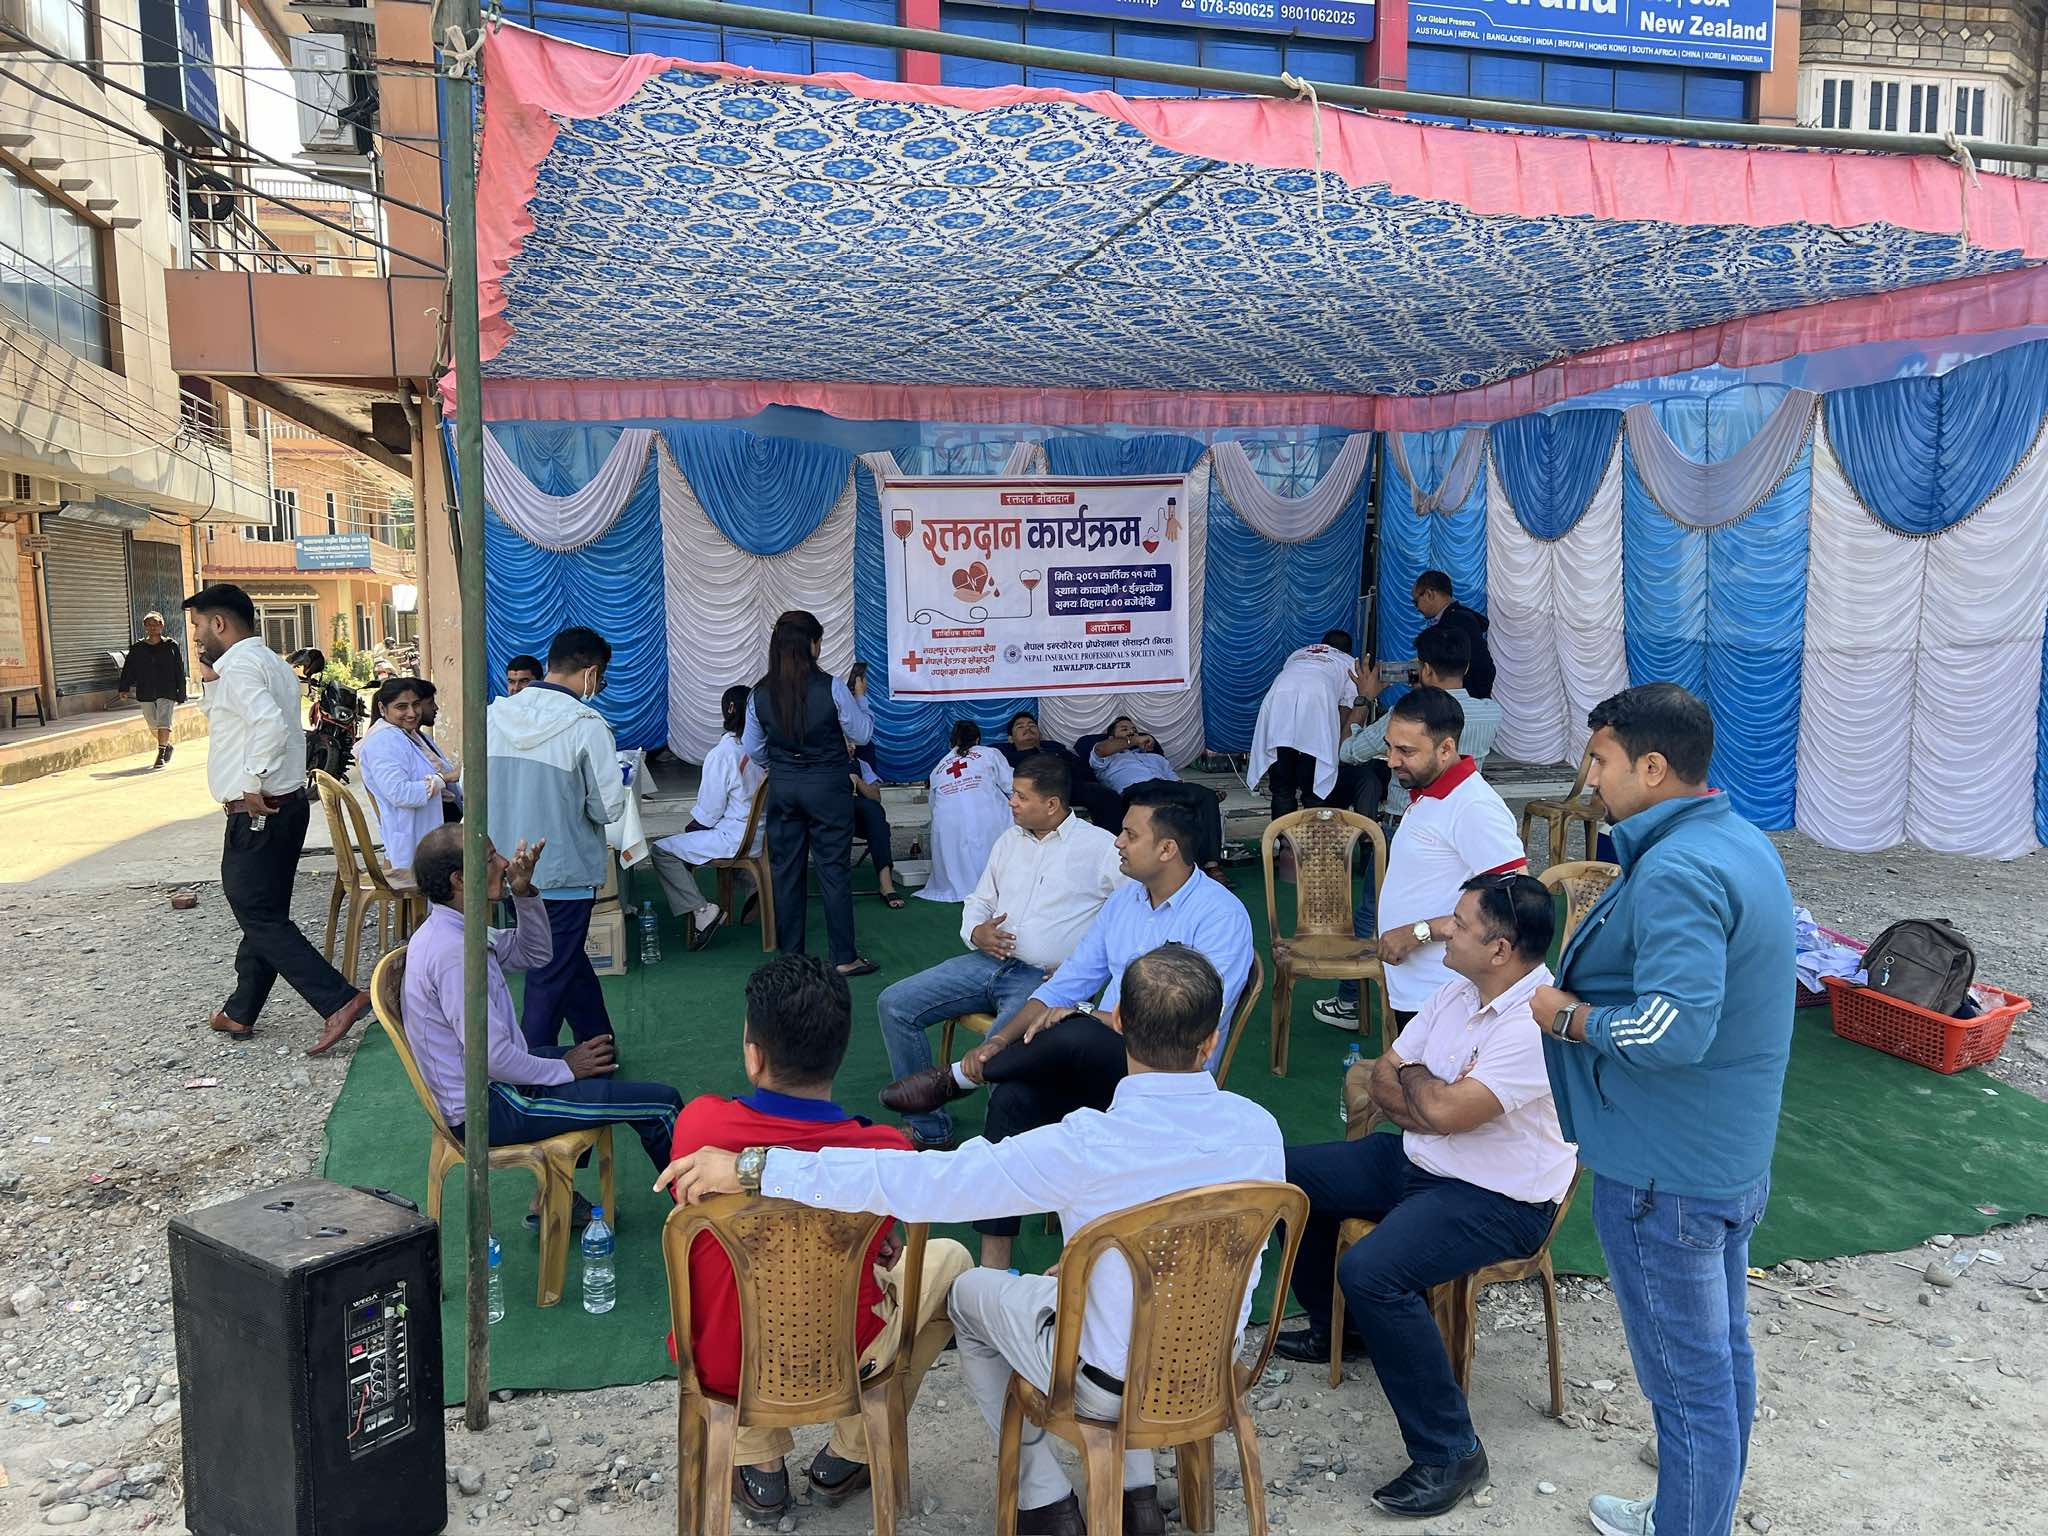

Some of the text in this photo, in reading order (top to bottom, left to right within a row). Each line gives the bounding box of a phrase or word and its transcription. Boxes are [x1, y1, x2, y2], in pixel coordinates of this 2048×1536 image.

[1200, 0, 1356, 25] 078-590625 9801062025
[1416, 14, 1476, 27] Our Global Presence
[1640, 11, 1767, 41] New Zealand
[1416, 27, 1764, 63] AUSTRALIA NEPAL BANGLADESH INDIA BHUTAN HONG KONG SOUTH AFRICA CHINA KOREA INDONESIA
[1659, 376, 1687, 391] New
[921, 504, 1142, 566] रक्तदान कार्यक्रम
[1076, 572, 1099, 583] २०८१
[1100, 568, 1130, 580] कार्तिक
[1131, 570, 1143, 579] ११
[1143, 568, 1157, 579] गते
[1024, 654, 1043, 663] NEPAL
[1044, 652, 1078, 662] INSURANCE
[1131, 649, 1155, 658] SOCIETY
